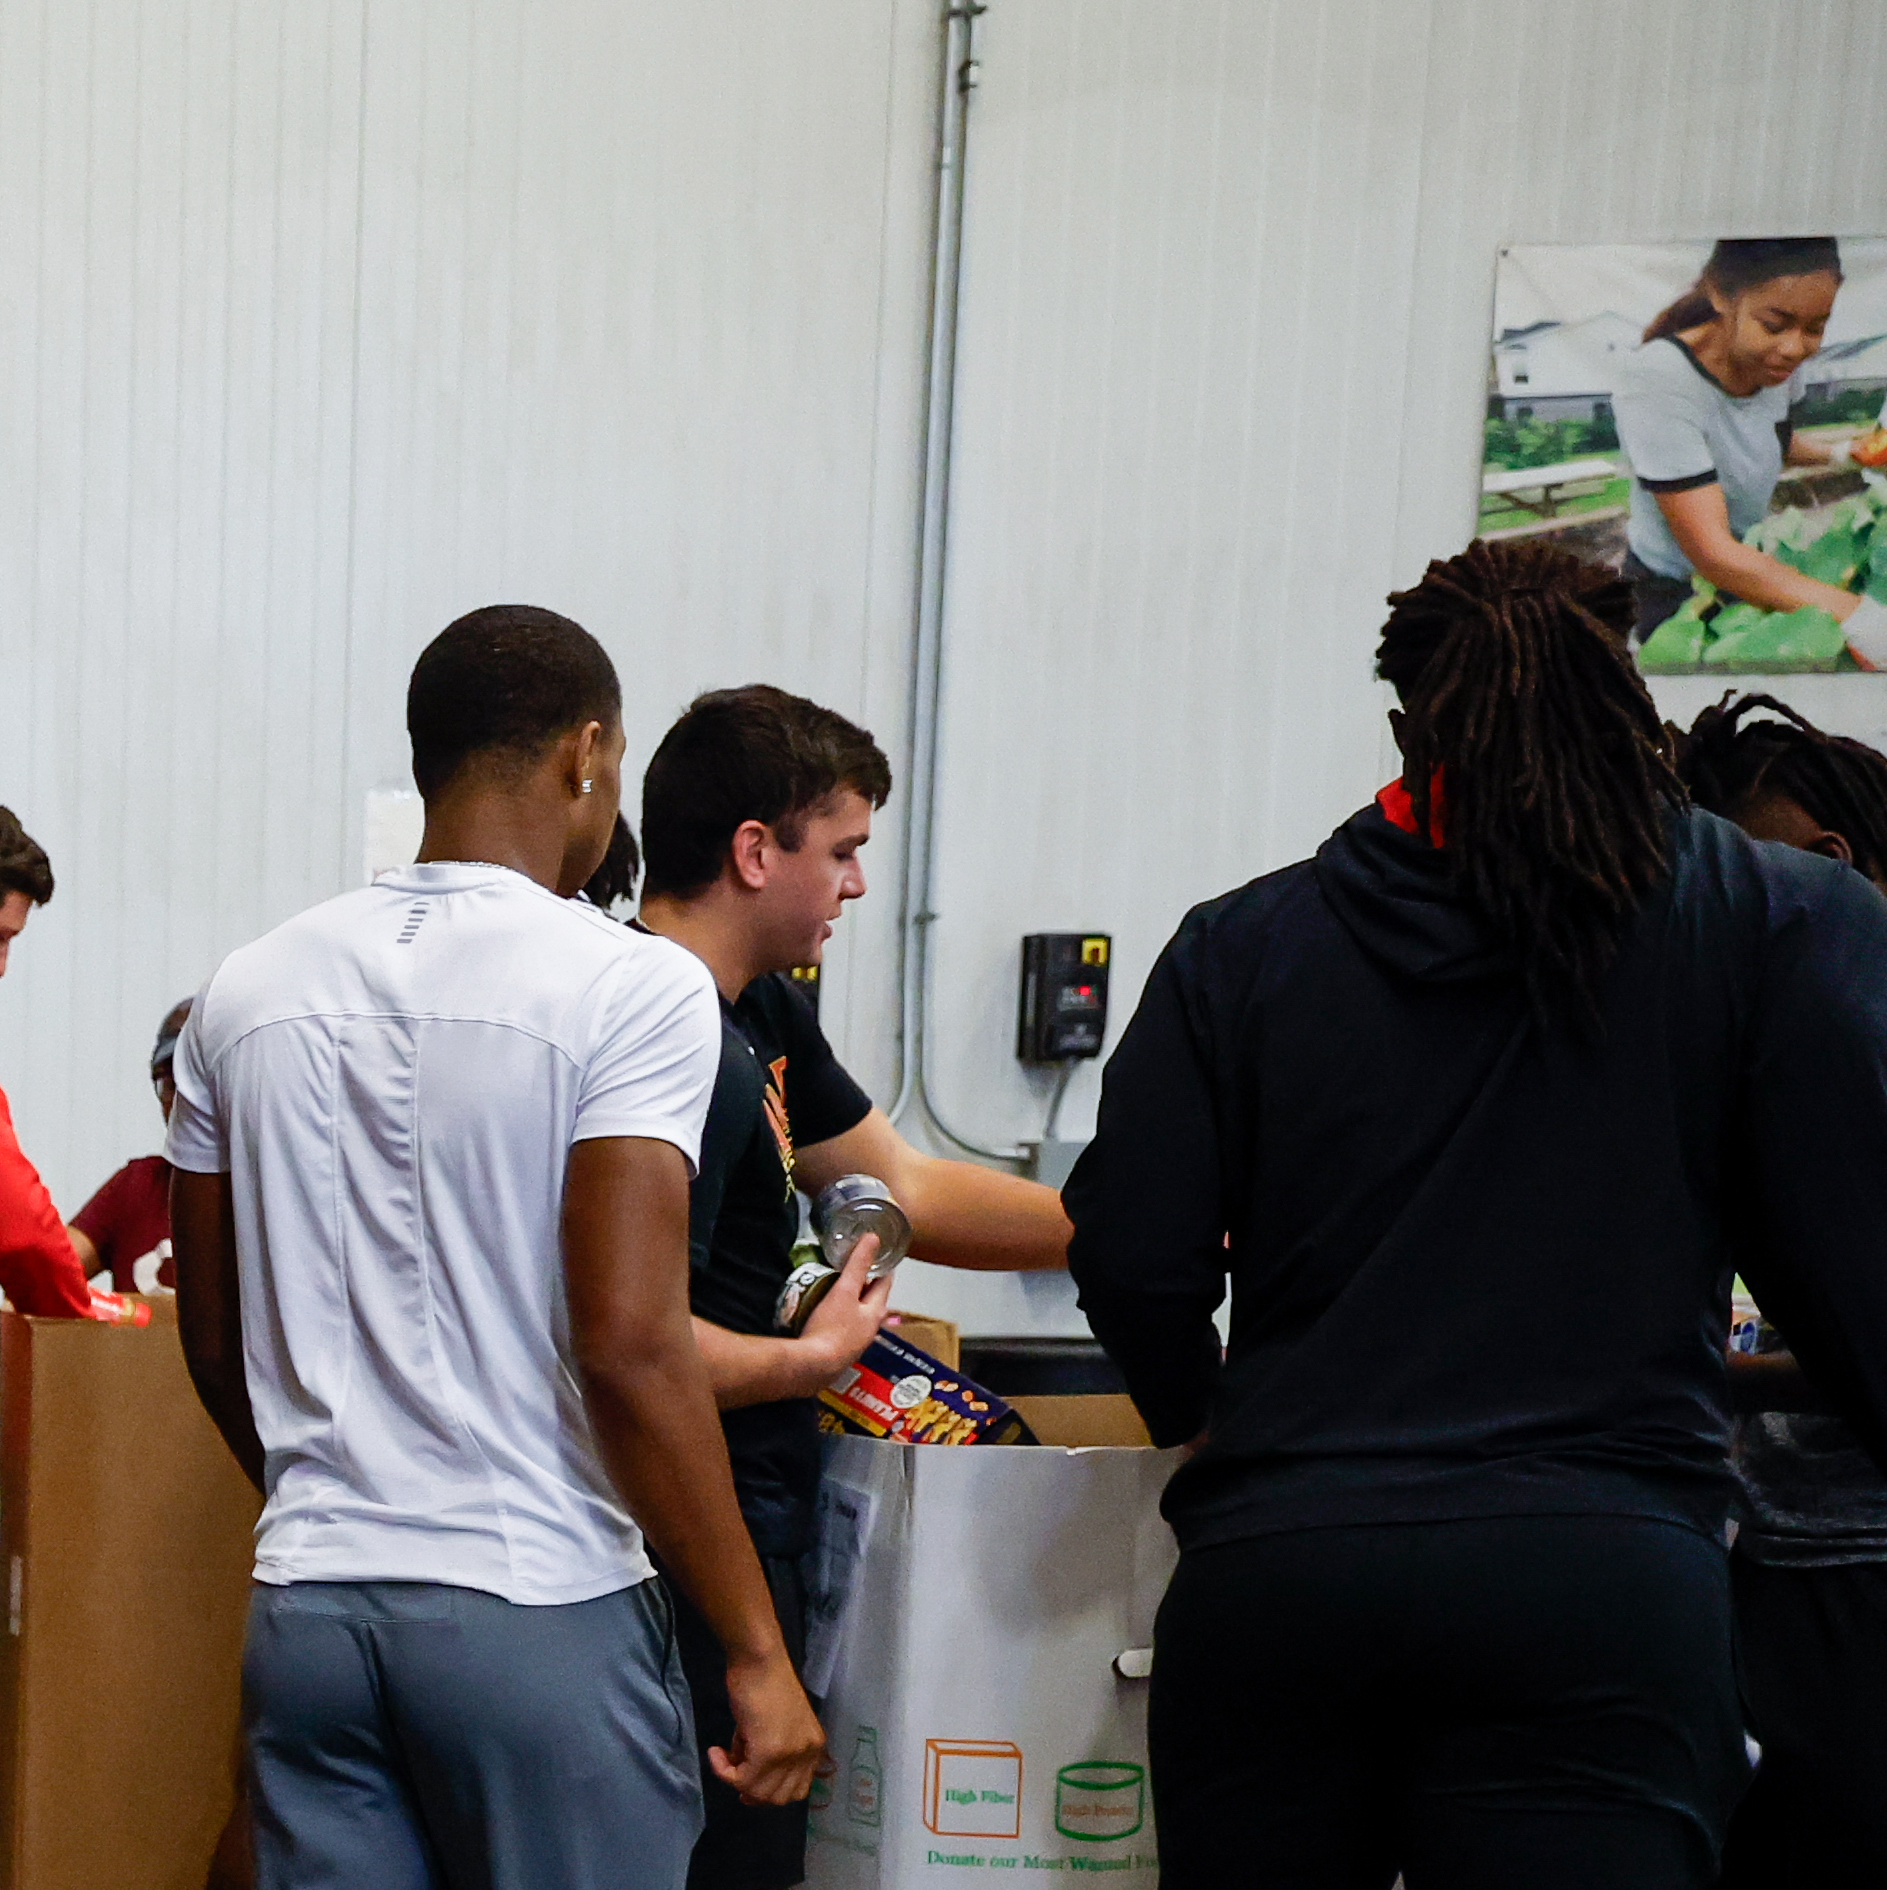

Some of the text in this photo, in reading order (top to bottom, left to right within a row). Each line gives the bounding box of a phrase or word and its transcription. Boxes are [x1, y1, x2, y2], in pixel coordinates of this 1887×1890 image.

[945, 1789, 977, 1805] High
[927, 1850, 985, 1867] Donate
[990, 1856, 1018, 1868] our
